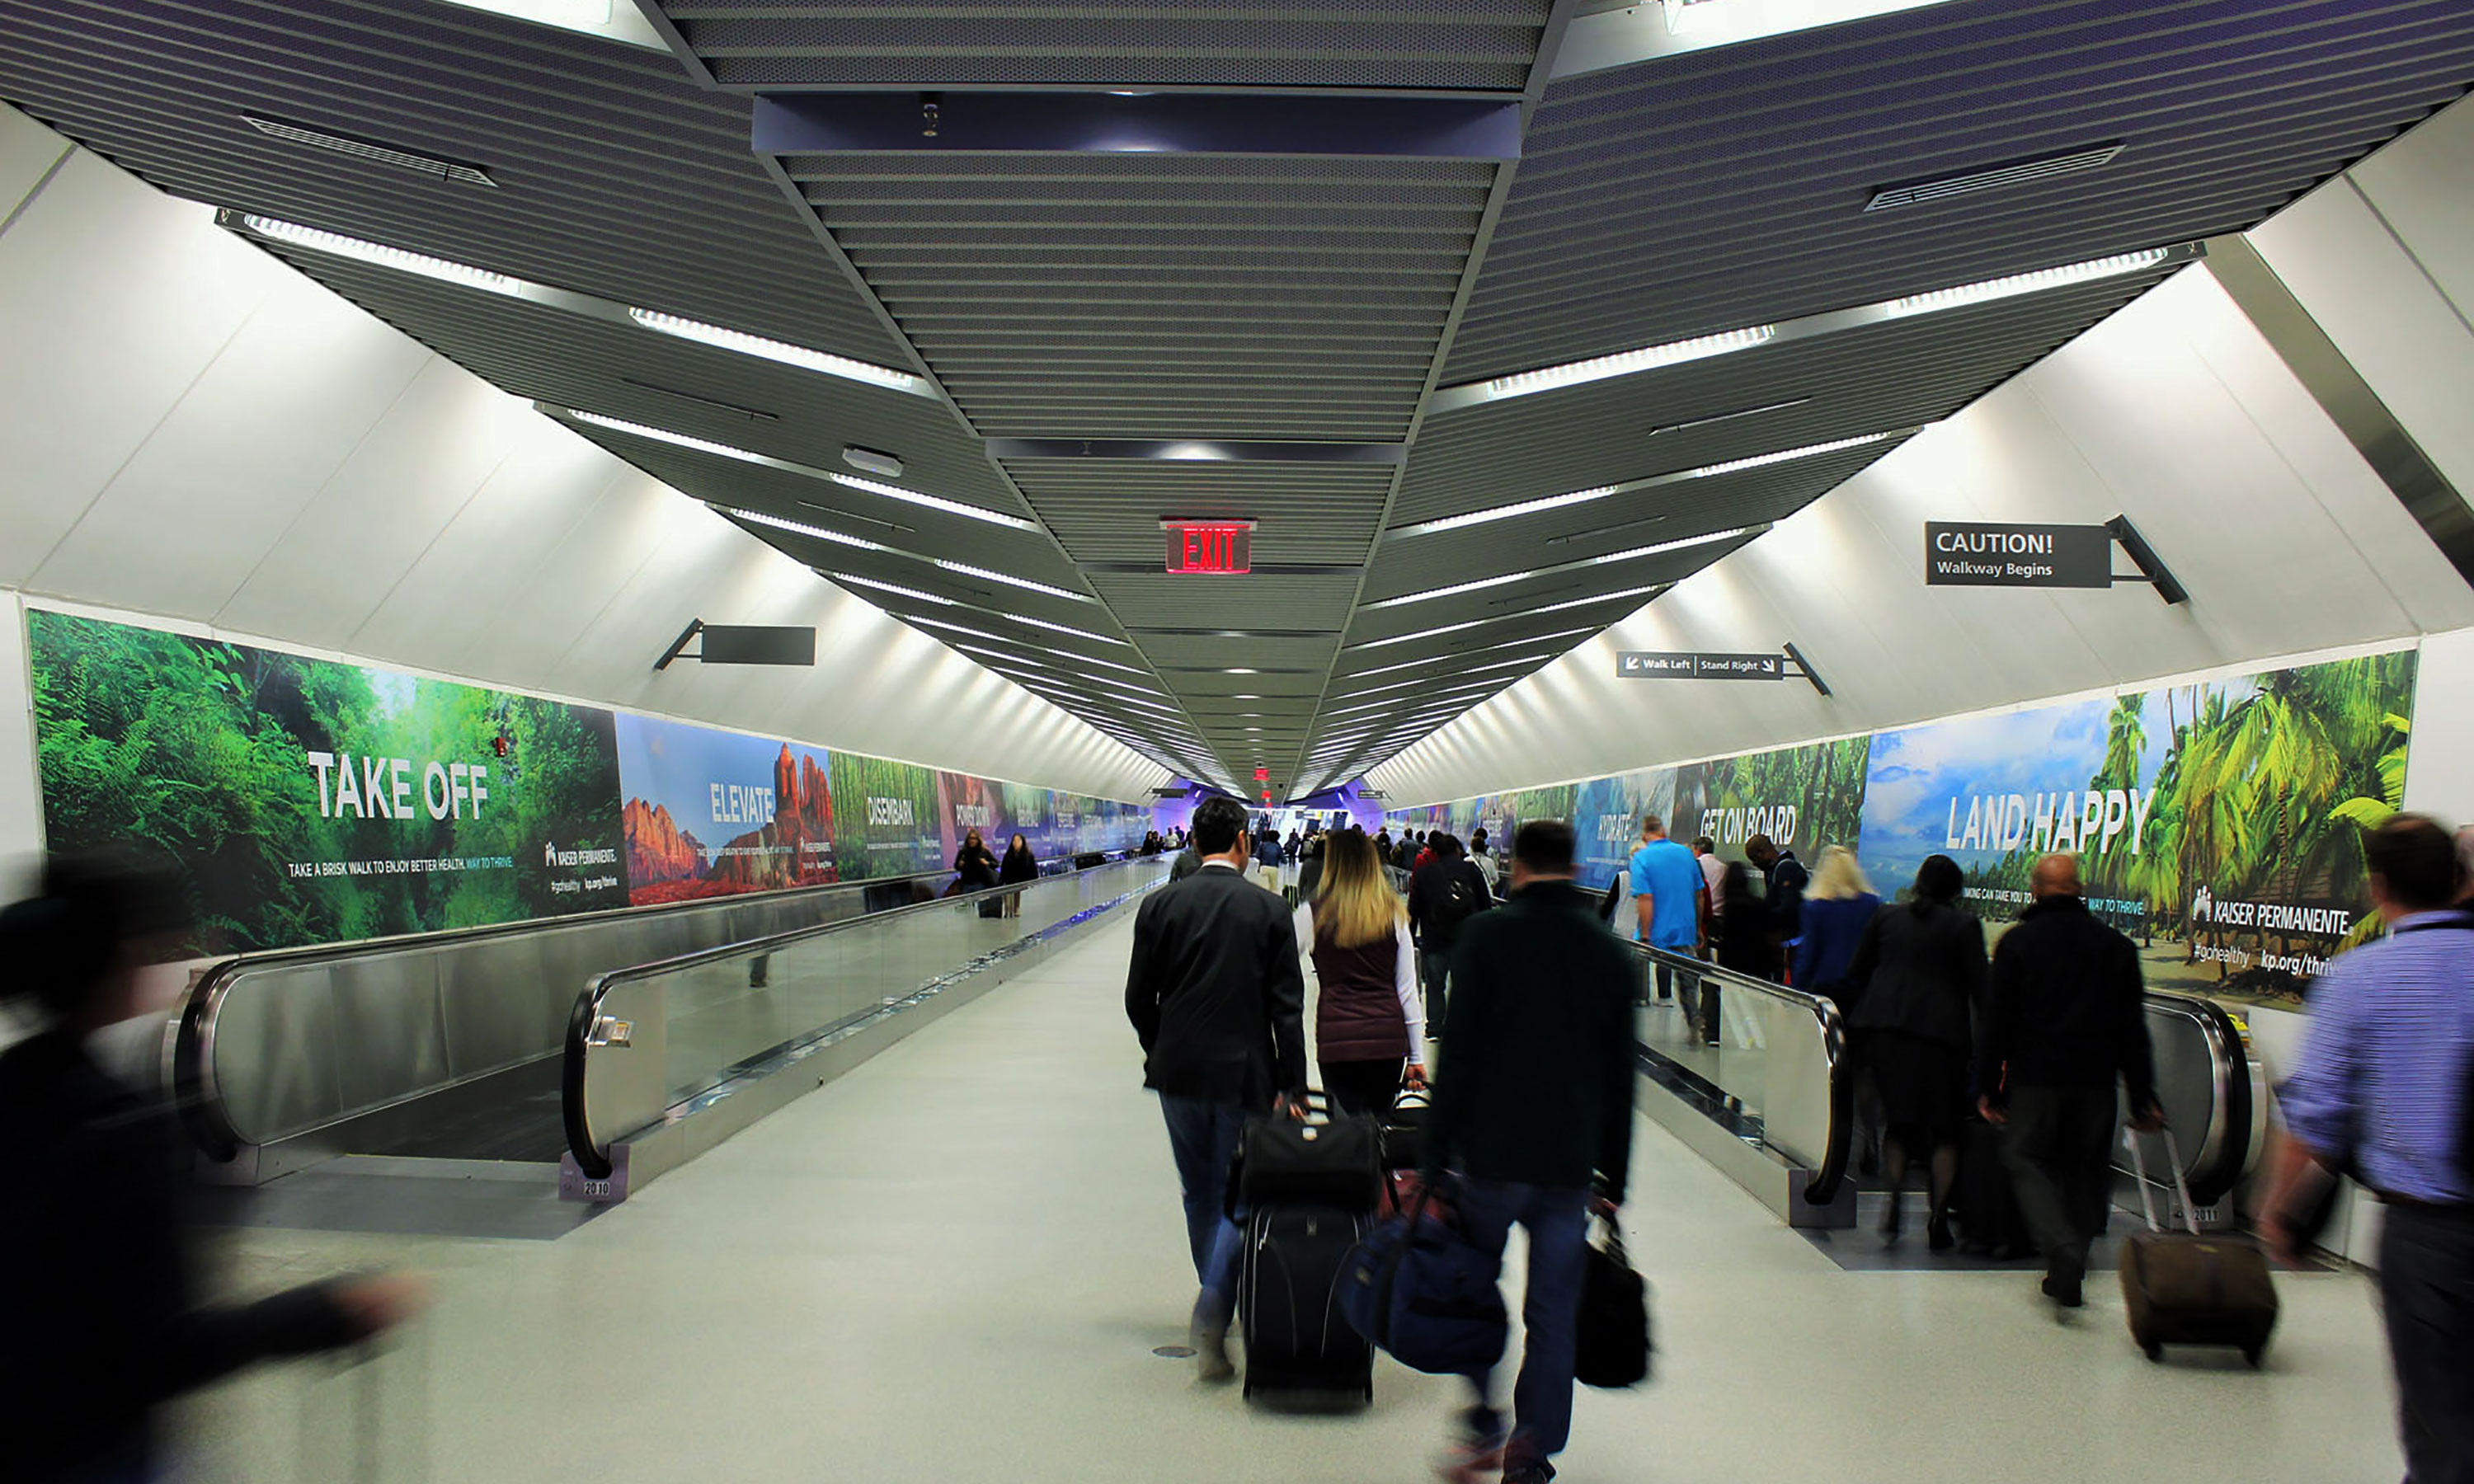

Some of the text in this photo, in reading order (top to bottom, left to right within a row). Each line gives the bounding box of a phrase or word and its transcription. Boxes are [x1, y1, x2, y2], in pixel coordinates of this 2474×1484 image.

[1183, 528, 1237, 570] EXIT
[1936, 533, 2053, 554] CAUTION!
[1937, 561, 2053, 578] Walkway Begins
[1644, 659, 1691, 669] Walk Left
[1701, 660, 1758, 672] Stand Right
[308, 751, 487, 820] TAKE OFF
[710, 783, 774, 823] ELEVATE
[868, 796, 914, 825] DISEMBARK
[1700, 805, 1796, 844] GET ON BOARD
[1946, 788, 2156, 855] LAND HAPPY
[289, 863, 312, 877] TAKE
[314, 863, 322, 876] A
[322, 862, 347, 876] BRISK
[348, 861, 373, 875] WALK
[373, 860, 384, 874] TO
[386, 859, 410, 873] ENJOY
[412, 859, 437, 872] BETTER
[1982, 888, 1994, 900] CAN
[1995, 890, 2010, 902] TAKE
[2011, 890, 2023, 903] YOU
[2024, 891, 2033, 904] TO
[2088, 897, 2104, 911] WAY
[2105, 899, 2115, 913] TO
[2214, 901, 2254, 926] KAISER
[2194, 944, 2340, 976] #gohealthy kp.org/thriv
[584, 1181, 609, 1195] 2010
[2194, 1209, 2218, 1221] 2011
